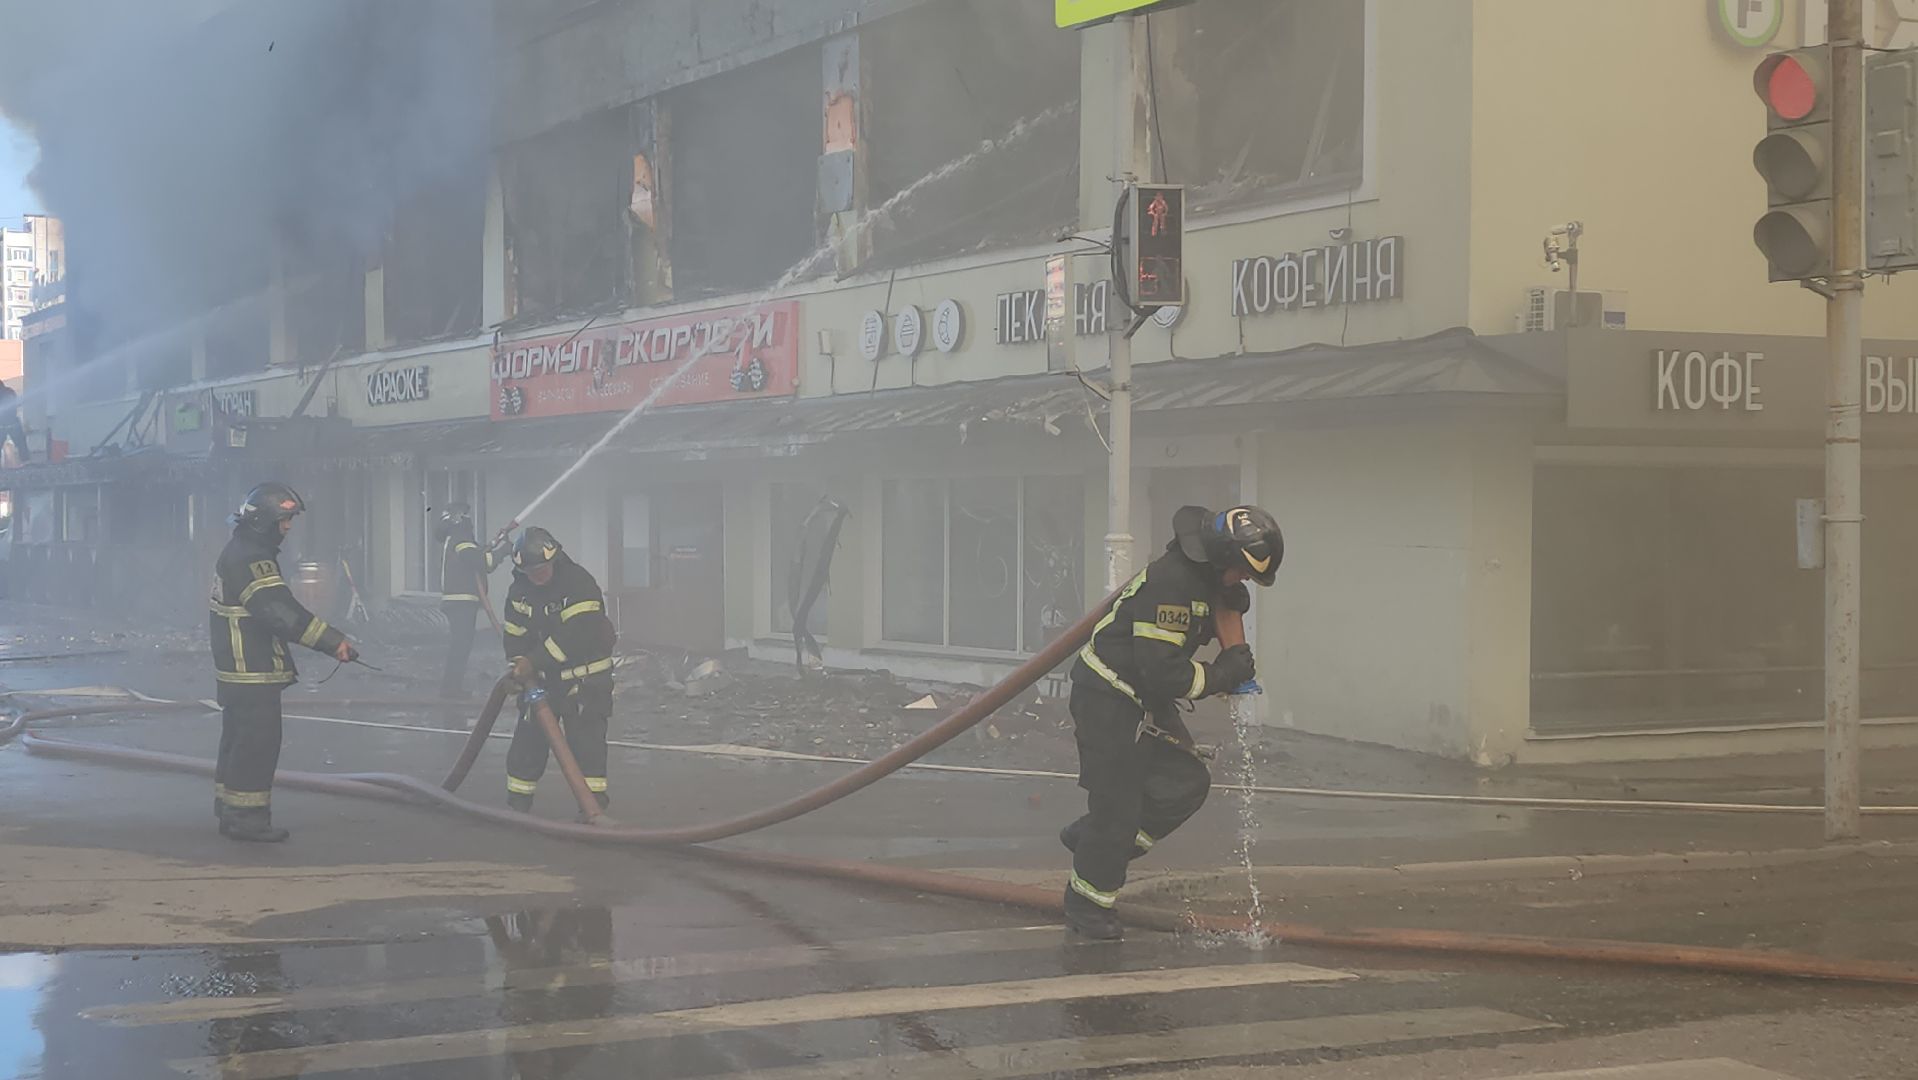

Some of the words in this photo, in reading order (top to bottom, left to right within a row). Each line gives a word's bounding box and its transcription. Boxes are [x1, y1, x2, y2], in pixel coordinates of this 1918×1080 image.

[1232, 229, 1397, 316] КОФЕЙНЯ
[996, 280, 1108, 344] ПЕКНЯ
[367, 367, 424, 404] КАРАОКЕ
[1656, 350, 1765, 412] КОФЕ
[1866, 356, 1918, 413] ВЫ
[1158, 610, 1189, 625] 0342
